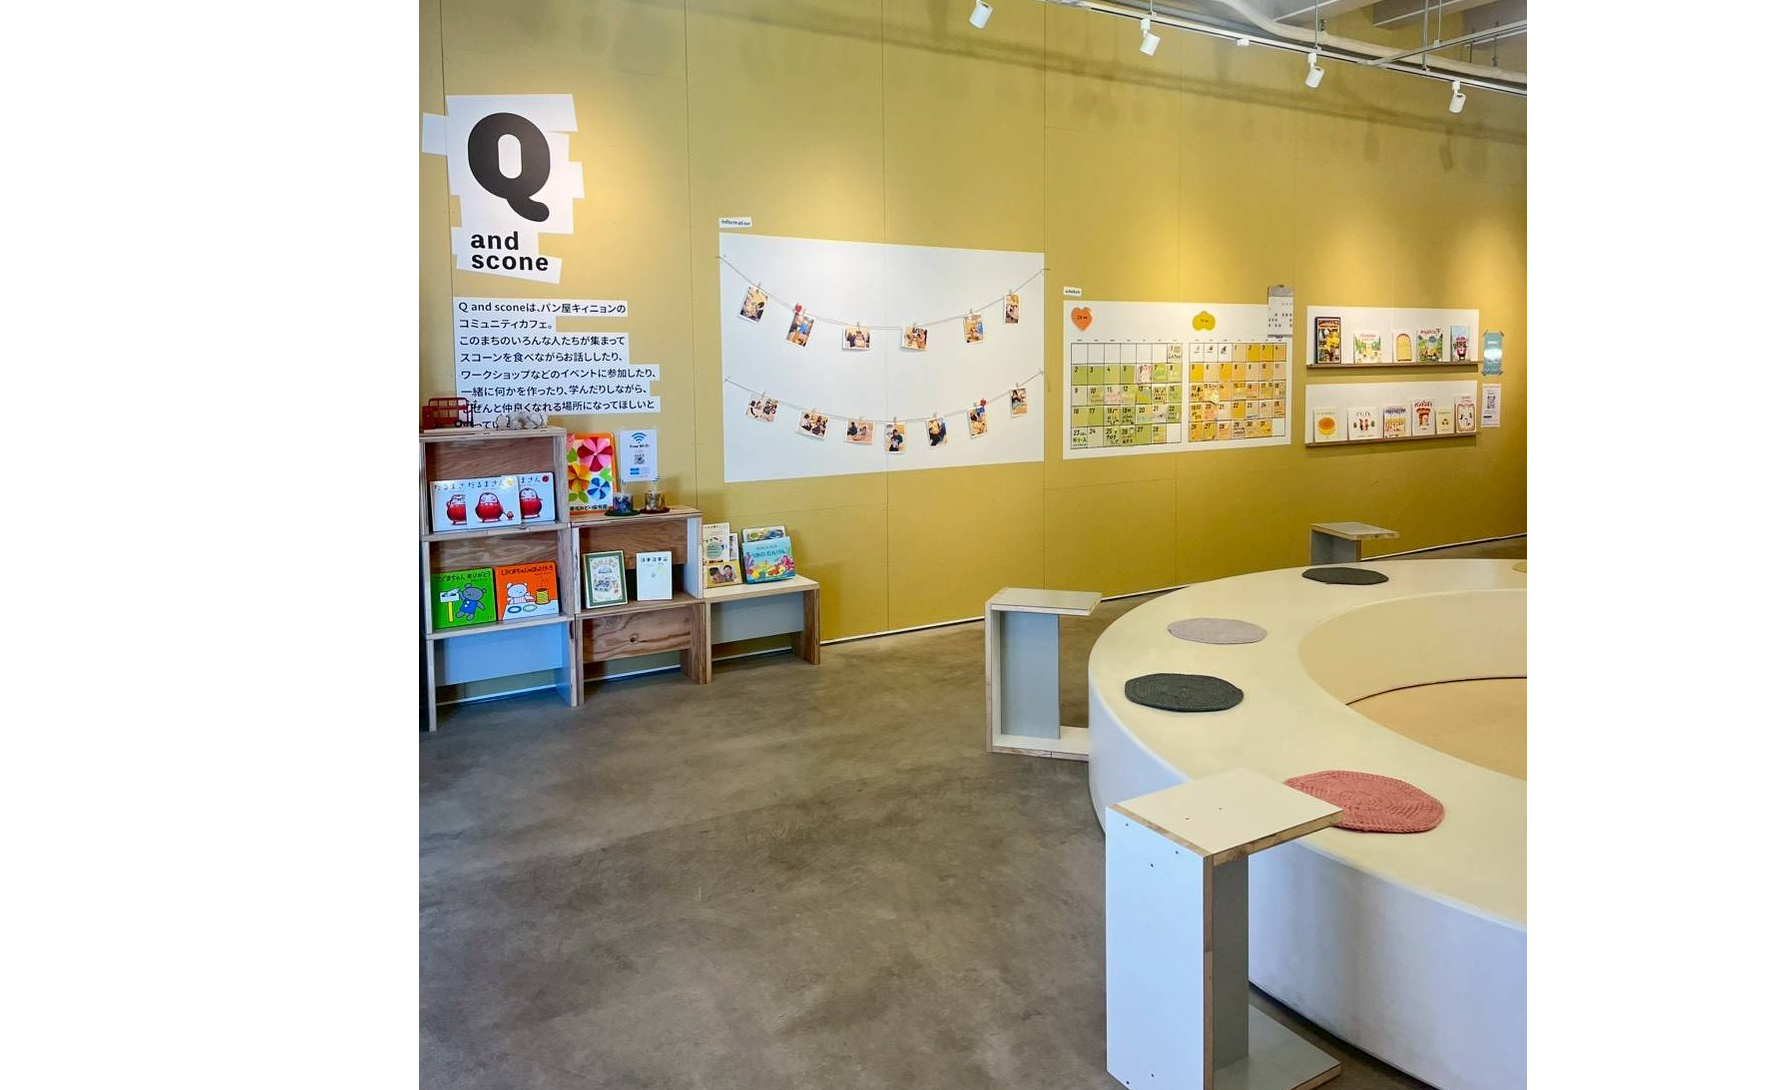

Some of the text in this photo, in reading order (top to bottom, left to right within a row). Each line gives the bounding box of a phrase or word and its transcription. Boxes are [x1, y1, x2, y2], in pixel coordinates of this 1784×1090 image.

[468, 112, 551, 223] Q
[470, 231, 519, 251] and
[471, 253, 549, 272] scone
[458, 302, 468, 313] Q
[471, 302, 492, 312] and
[460, 319, 553, 330] コミュニティカフェ。
[460, 335, 625, 346] このまちのいろんな人たちが集まって
[460, 352, 623, 363] スコーンを食べながらお話ししたり、
[461, 369, 656, 380] ワークショップなどのイベントに参加したり、
[461, 385, 647, 397] 一緒に何かを作ったり、学んだりしながら、
